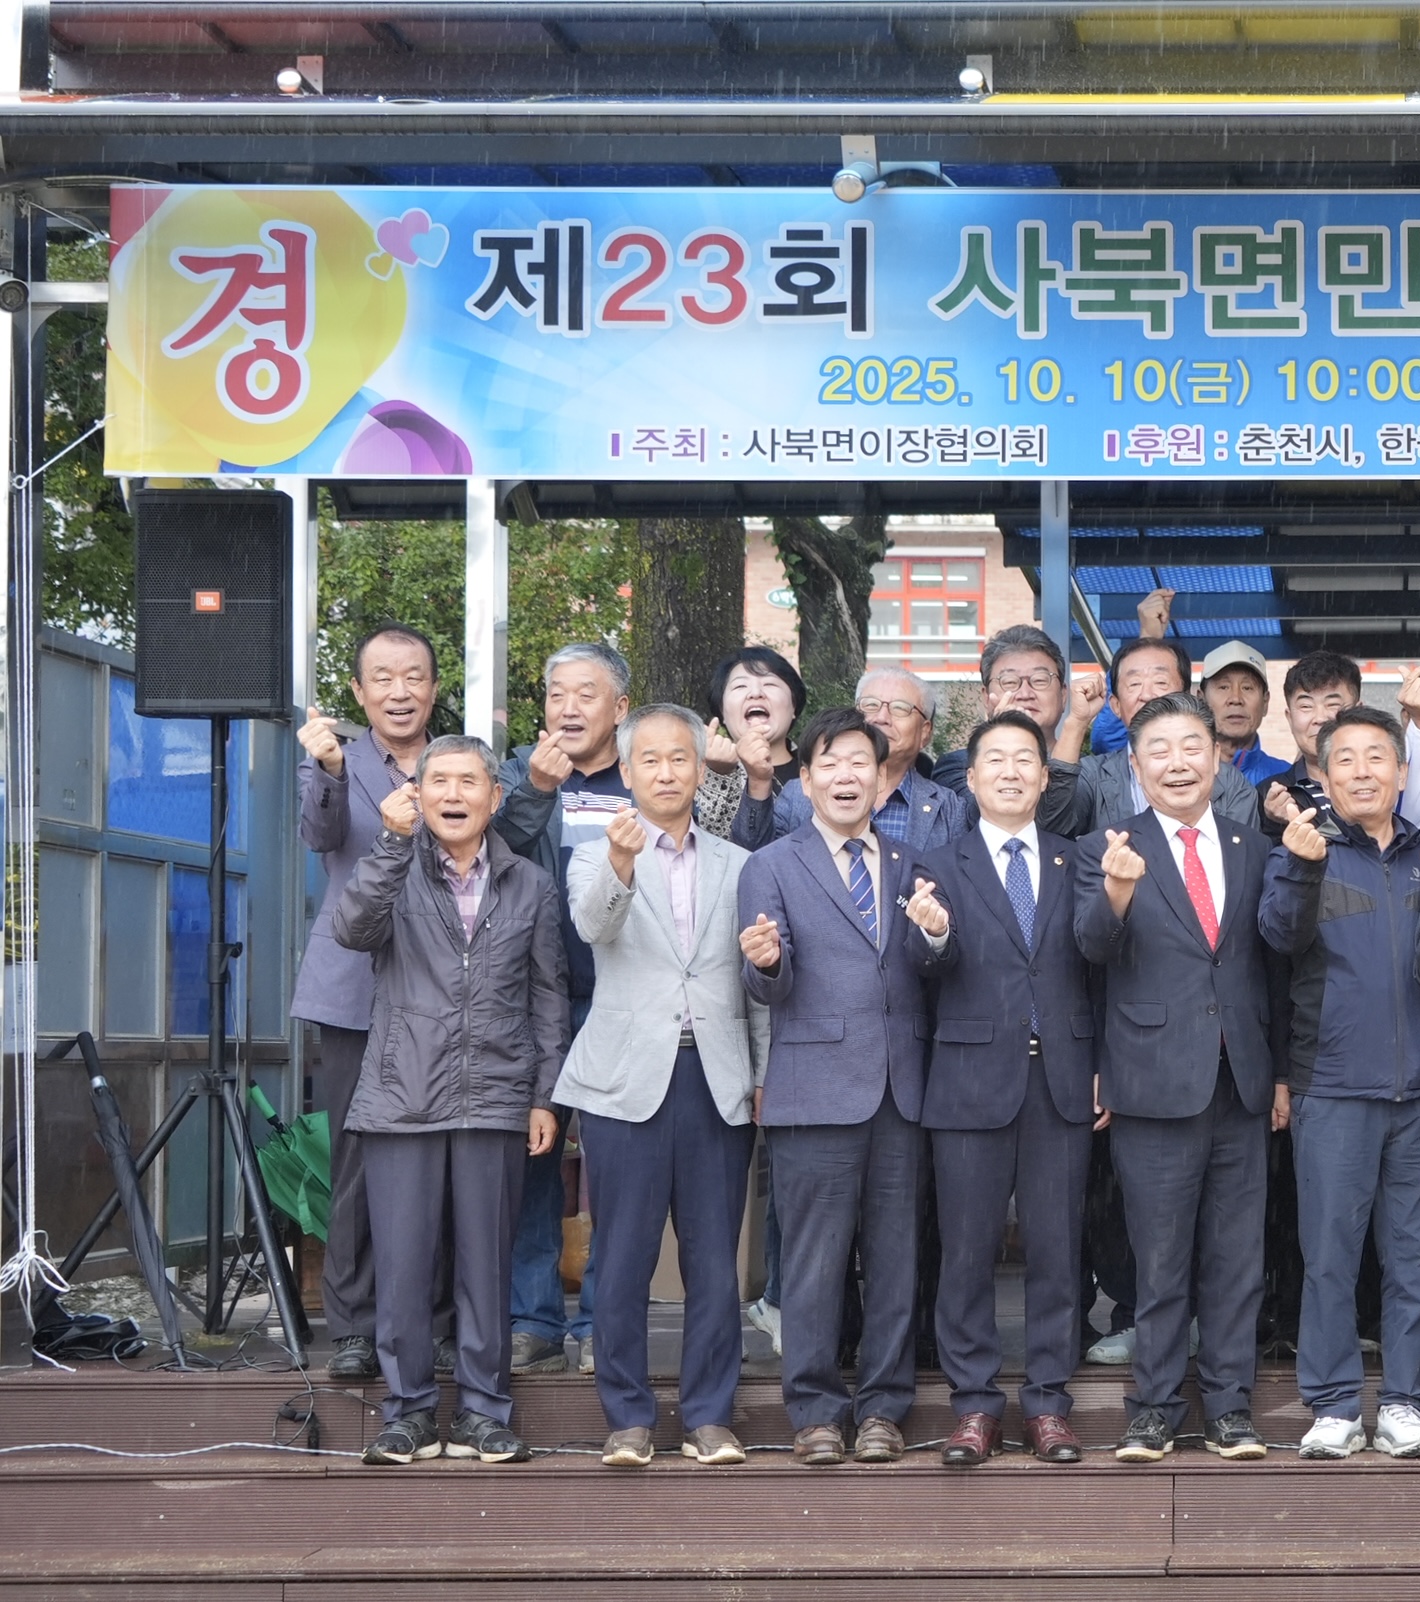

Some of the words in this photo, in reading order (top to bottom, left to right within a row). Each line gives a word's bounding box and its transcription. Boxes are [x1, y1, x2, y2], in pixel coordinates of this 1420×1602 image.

[472, 225, 868, 333] 제23회
[168, 225, 311, 418] 경
[821, 360, 970, 403] 2025.
[999, 360, 1075, 403] 10.
[1104, 359, 1252, 405] 10(금)
[633, 428, 706, 463] 주최
[743, 427, 1046, 464] 사북면이장협의회
[1128, 426, 1203, 462] 후원
[1238, 427, 1363, 465] 춘천시,
[200, 596, 216, 606] JBL
